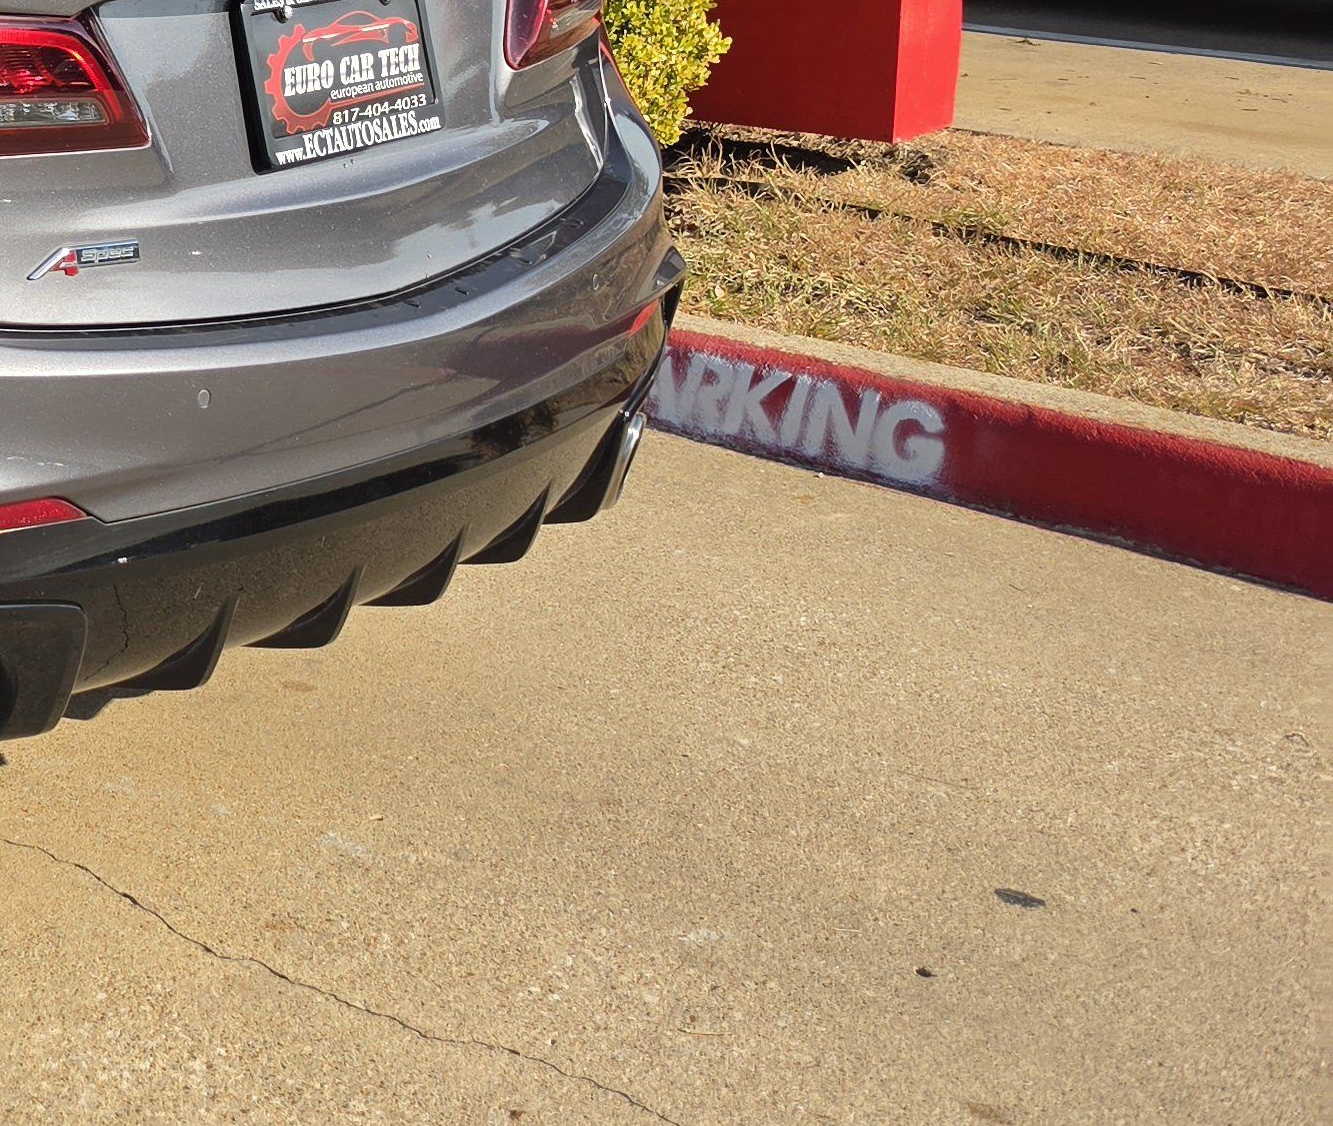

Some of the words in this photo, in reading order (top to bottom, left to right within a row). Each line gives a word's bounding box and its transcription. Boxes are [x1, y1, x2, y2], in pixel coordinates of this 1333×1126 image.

[283, 60, 335, 97] EURO
[339, 52, 375, 85] CAR
[378, 43, 421, 77] TECH
[330, 82, 375, 100] european
[374, 71, 424, 92] automotive
[332, 93, 427, 125] 817-404-4033
[274, 110, 442, 166] www.ECTAUTOSALES.com
